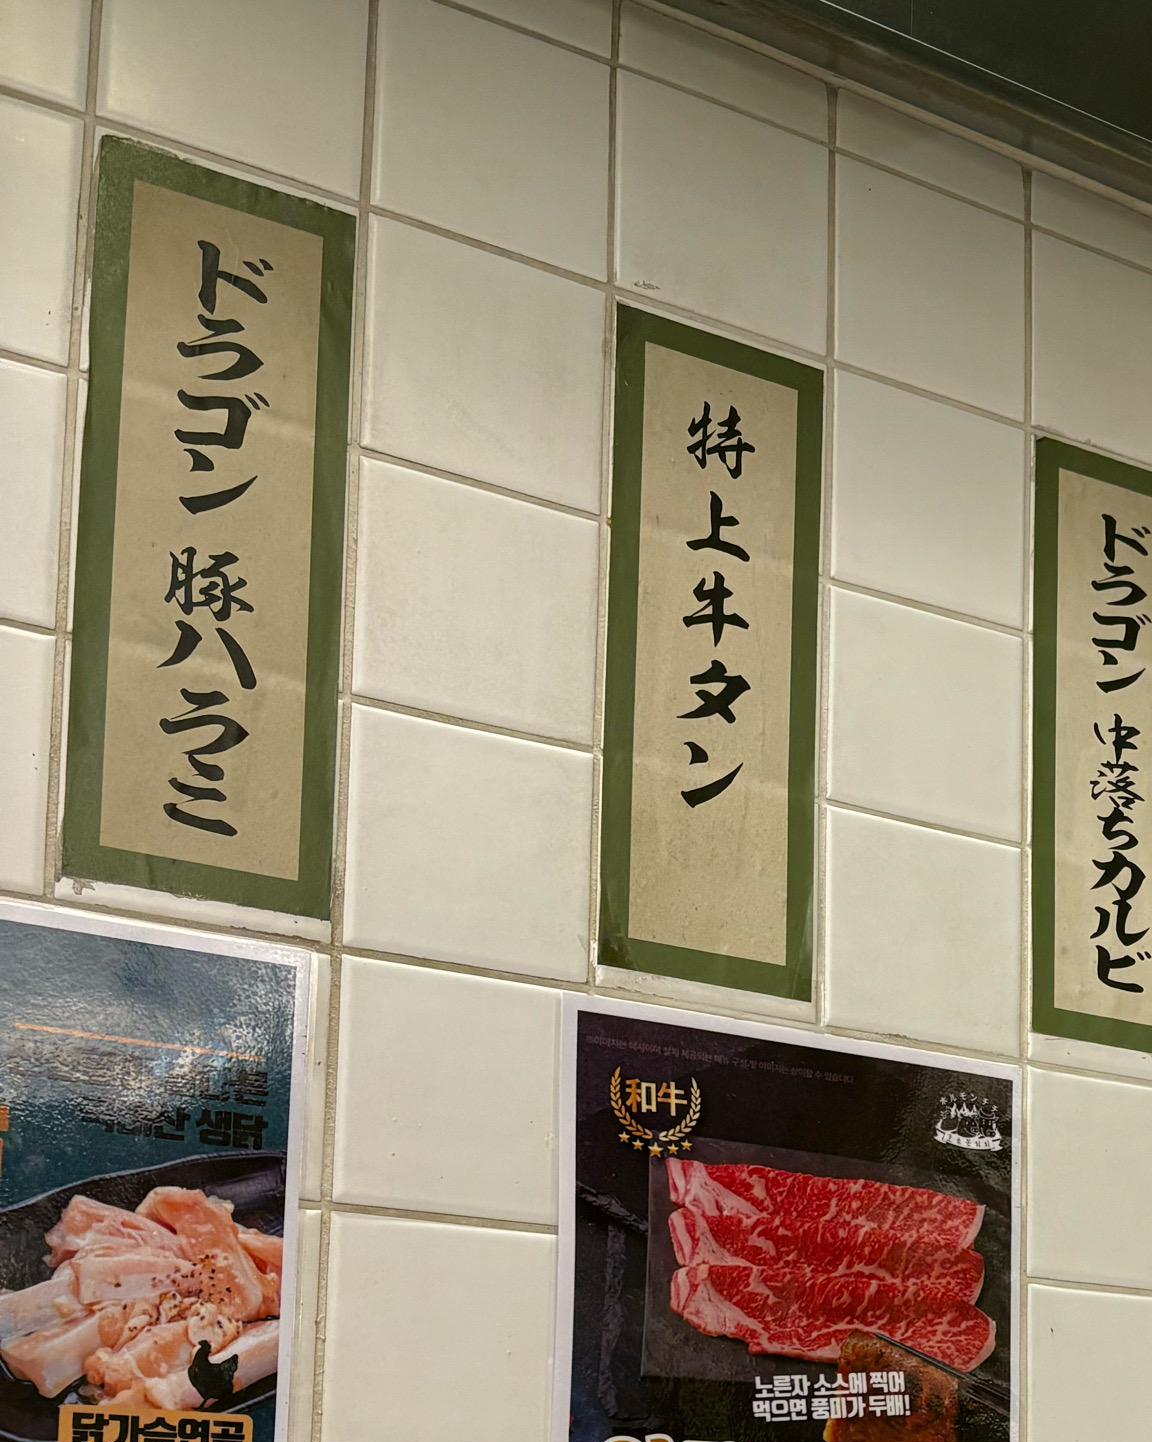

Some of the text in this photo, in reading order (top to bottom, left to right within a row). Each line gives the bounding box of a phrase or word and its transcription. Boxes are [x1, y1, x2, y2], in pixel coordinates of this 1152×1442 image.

[156, 239, 273, 838] ドラゴン 豚ハラミ
[676, 400, 756, 808] 特上牛タン
[1089, 513, 1152, 994] ドラゴン 中落ちカルビ
[624, 1076, 688, 1117] 和牛
[196, 1108, 269, 1150] 생닭
[755, 1370, 905, 1399] 노른자 소스에 찍어
[752, 1393, 911, 1423] 먹으면 풍미가 두배!
